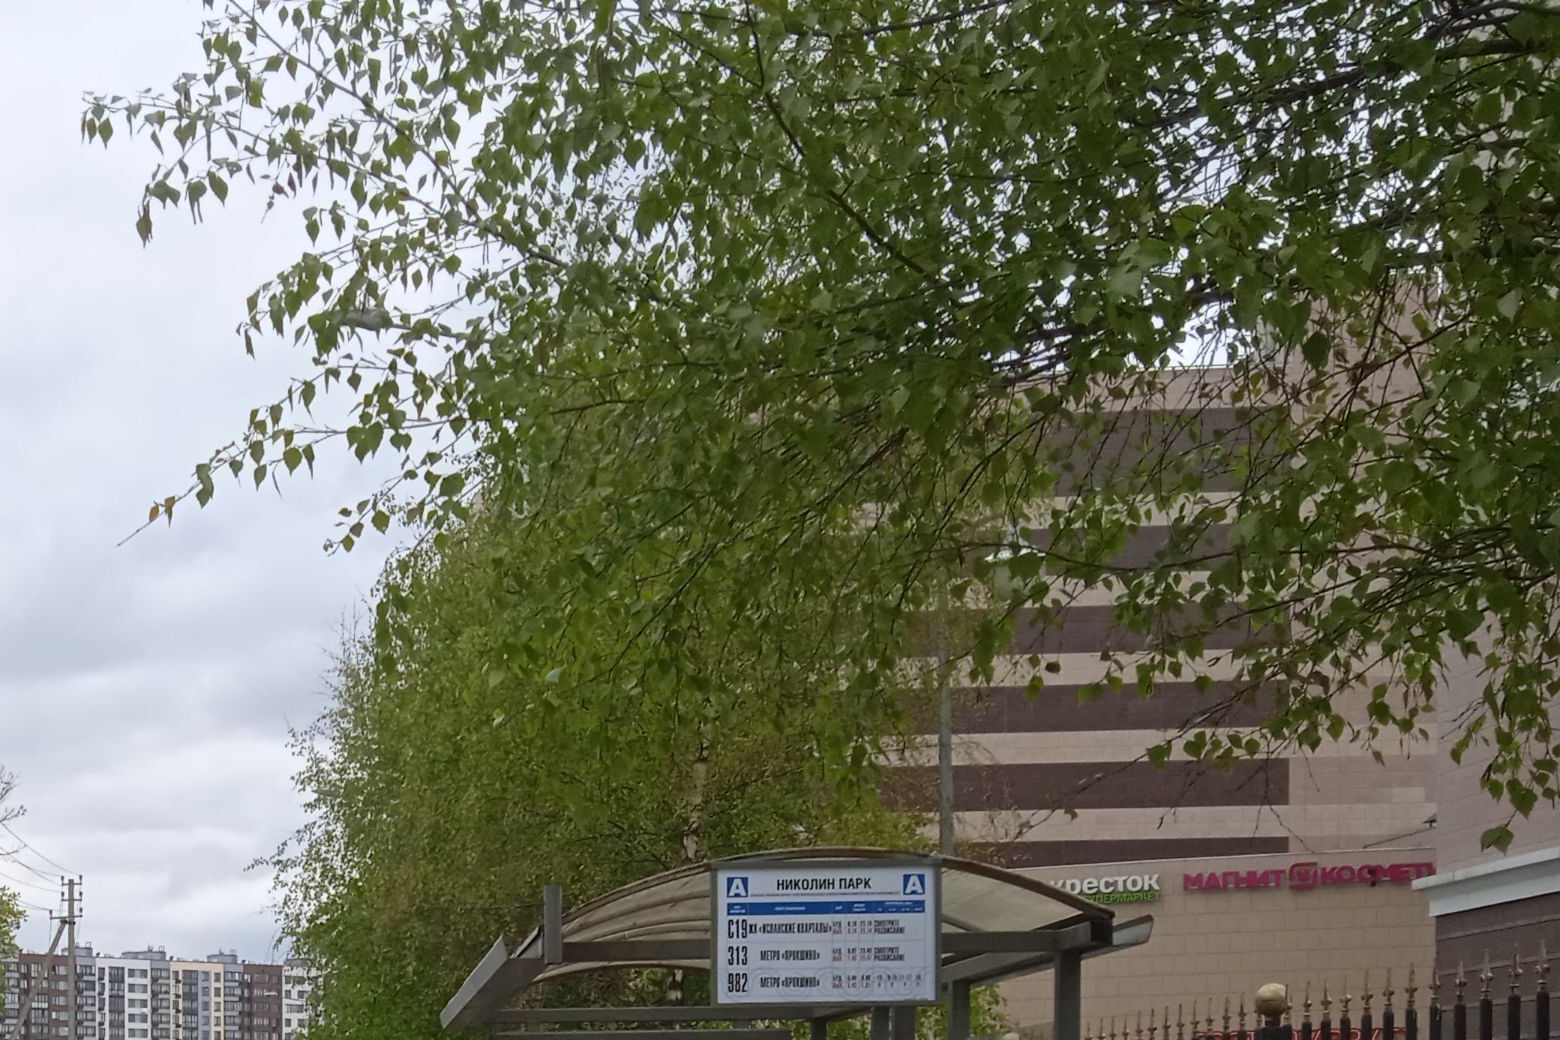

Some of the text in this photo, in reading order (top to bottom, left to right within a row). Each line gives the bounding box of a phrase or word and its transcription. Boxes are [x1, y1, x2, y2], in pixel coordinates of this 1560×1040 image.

[777, 877, 872, 891] НИКОЛИН ПАРК
[1184, 868, 1285, 891] МАГНИТ
[728, 946, 748, 965] 313
[728, 973, 748, 992] 982
